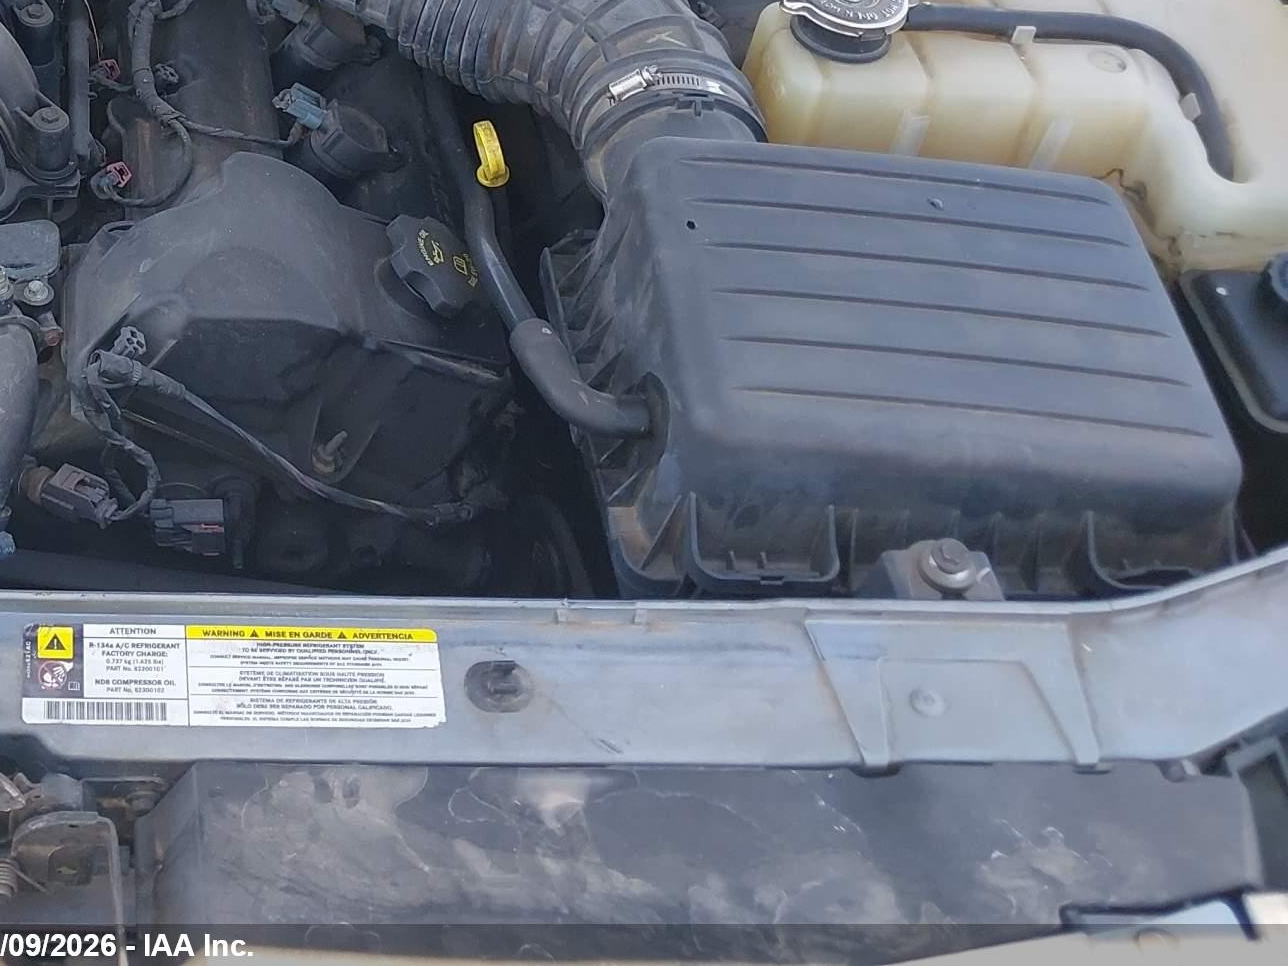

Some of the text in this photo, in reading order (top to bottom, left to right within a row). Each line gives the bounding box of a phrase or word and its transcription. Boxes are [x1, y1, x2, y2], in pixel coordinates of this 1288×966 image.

[109, 627, 157, 635] ATTENTION
[202, 629, 414, 640] WARNING MISE EN GARDE ADVERTENCIA
